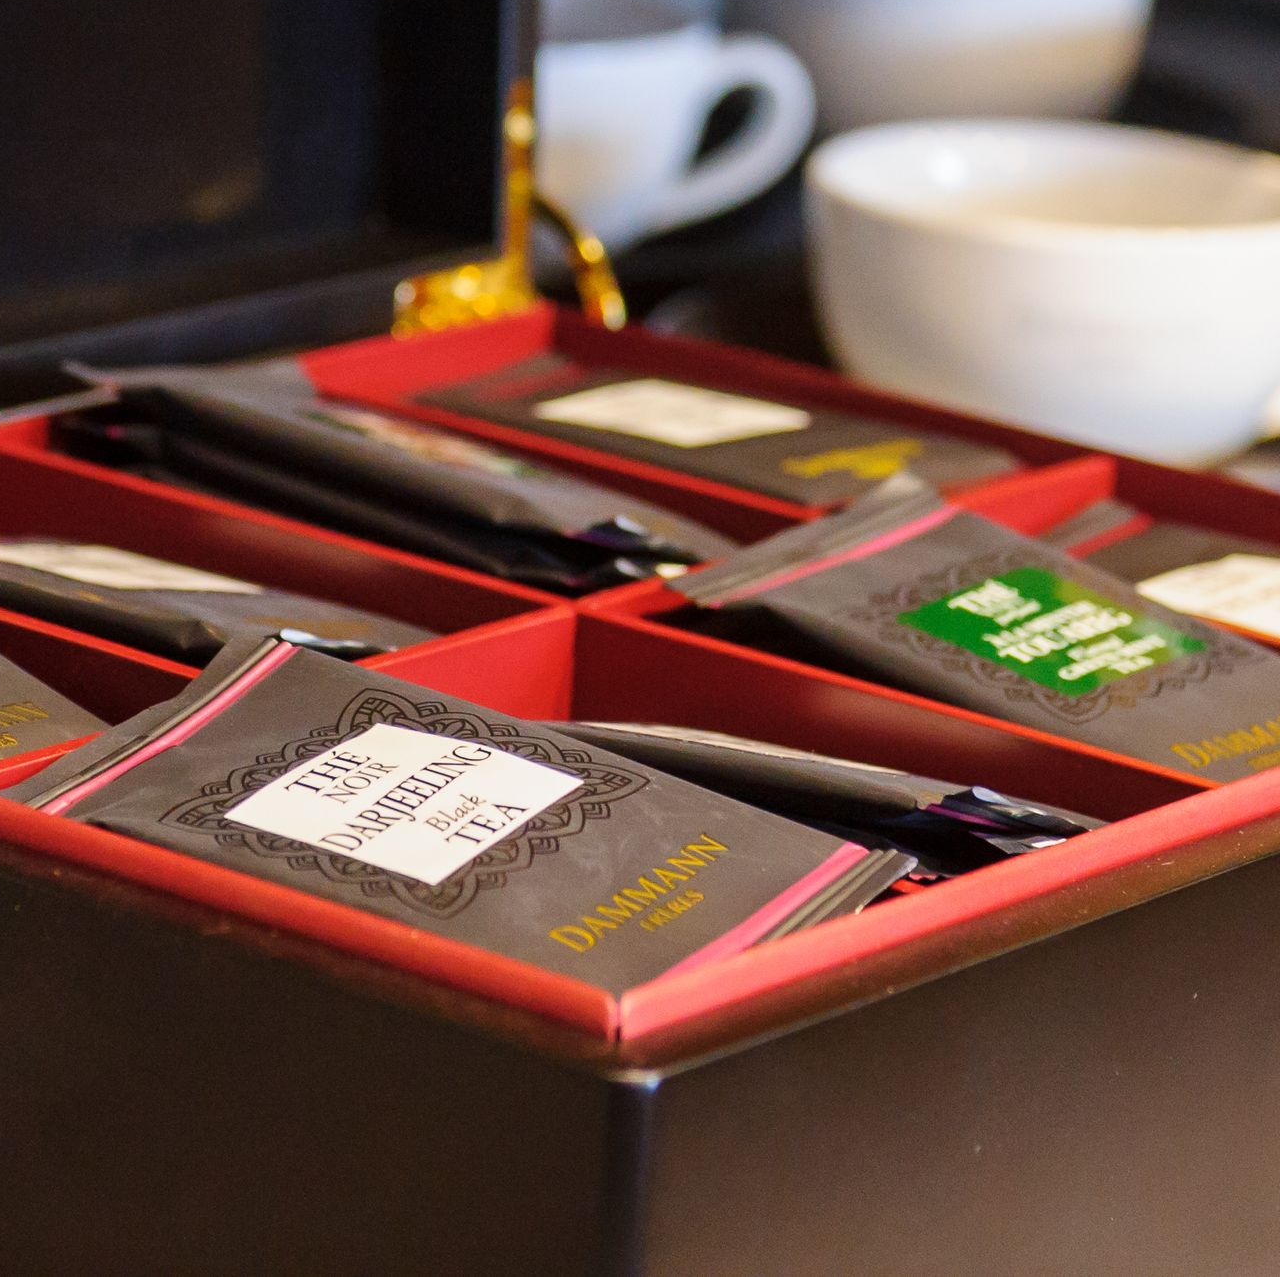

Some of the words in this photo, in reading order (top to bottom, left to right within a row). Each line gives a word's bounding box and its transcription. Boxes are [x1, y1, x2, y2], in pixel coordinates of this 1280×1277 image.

[284, 750, 373, 797] THÉ
[322, 761, 399, 805] NOIR
[317, 743, 495, 851] DARJEELING
[428, 792, 485, 834] Black
[445, 802, 530, 848] TEA
[548, 832, 729, 953] DAMMANN
